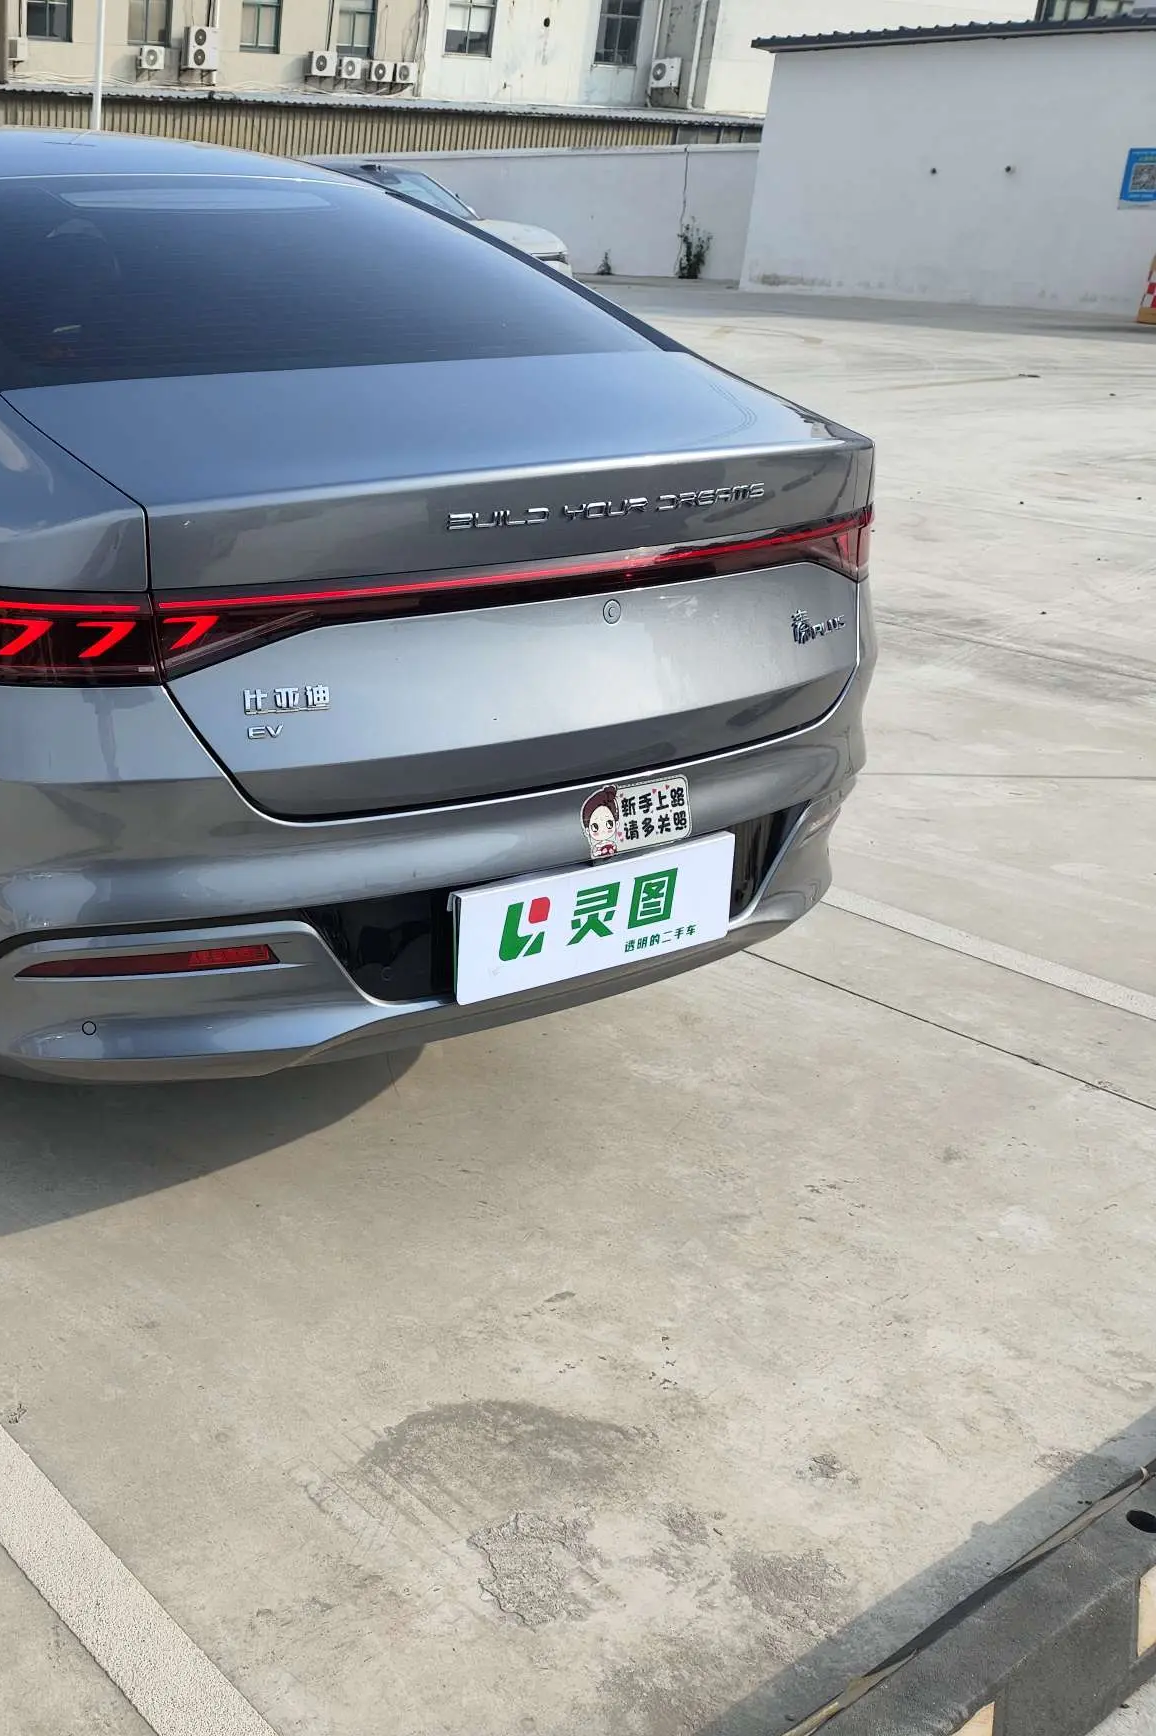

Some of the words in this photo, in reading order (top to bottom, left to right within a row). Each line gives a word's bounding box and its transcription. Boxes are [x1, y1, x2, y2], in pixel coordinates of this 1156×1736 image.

[447, 507, 549, 530] BUILD
[563, 497, 648, 520] YOUR
[656, 482, 765, 512] DREAMS
[243, 684, 330, 714] 比亚迪
[247, 725, 284, 740] EV
[621, 787, 685, 817] 新手上路
[624, 811, 687, 840] 请多关照
[567, 867, 678, 945] 灵图
[625, 924, 697, 952] 透明的二手车
